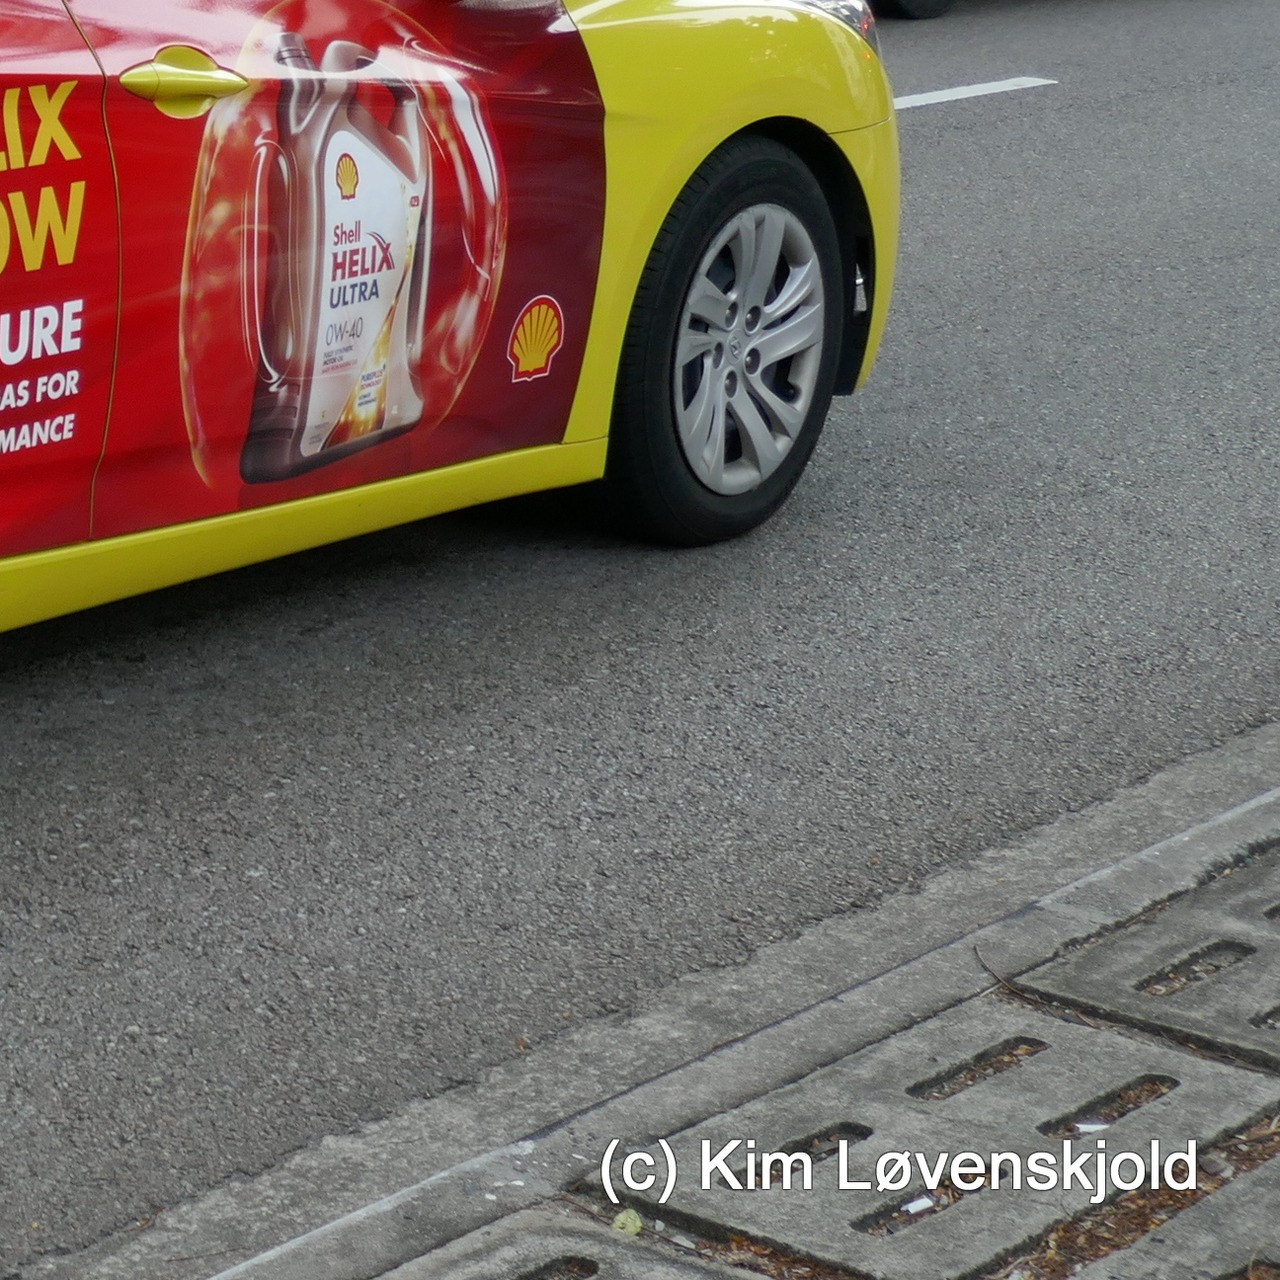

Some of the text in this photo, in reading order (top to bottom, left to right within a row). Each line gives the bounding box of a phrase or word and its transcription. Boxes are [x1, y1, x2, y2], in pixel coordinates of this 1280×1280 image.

[333, 220, 361, 246] Shell
[331, 239, 395, 282] HELIX
[329, 279, 380, 309] ULTRA
[35, 370, 80, 403] FOR
